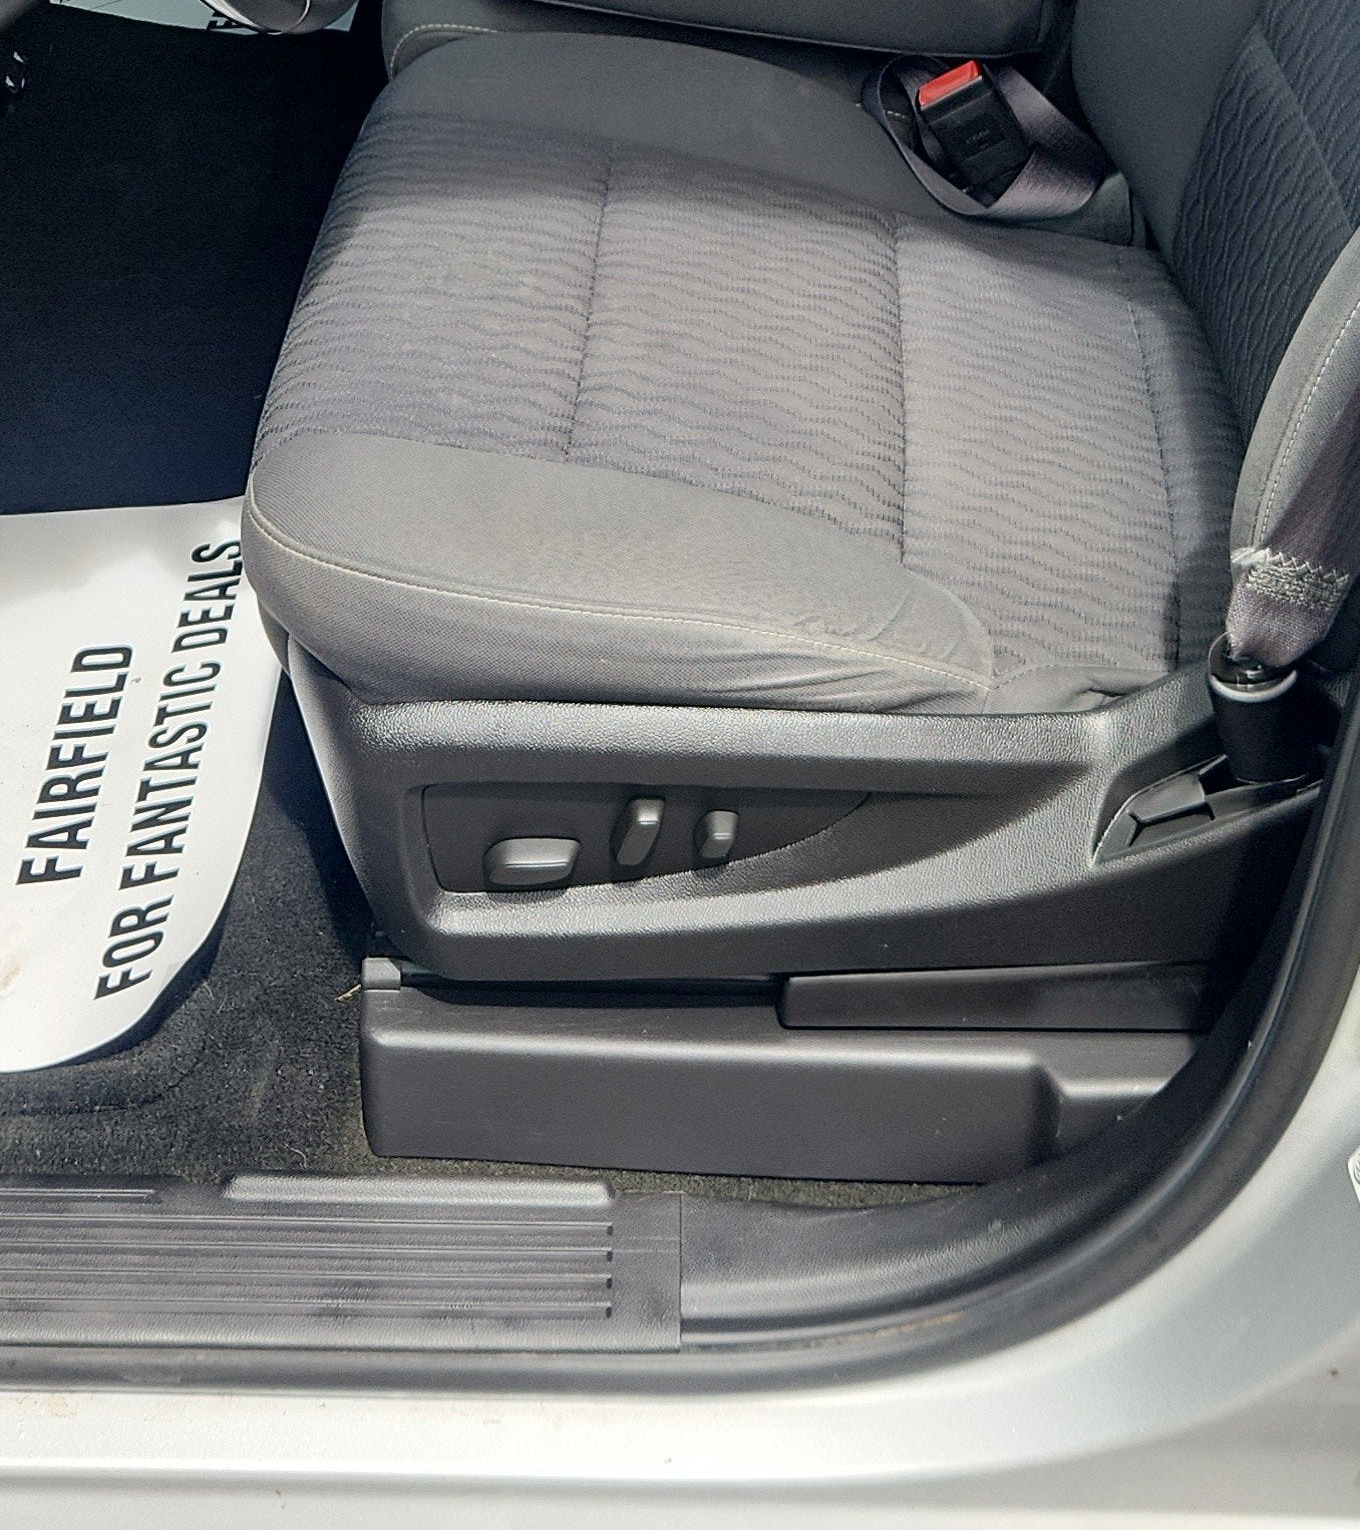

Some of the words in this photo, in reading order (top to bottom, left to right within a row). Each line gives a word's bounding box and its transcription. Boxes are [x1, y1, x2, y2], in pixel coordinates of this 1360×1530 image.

[171, 540, 243, 654] DEALS
[15, 643, 134, 886] FAIRFIELD
[118, 660, 222, 891] FANTASTIC
[93, 893, 175, 1000] FOR
